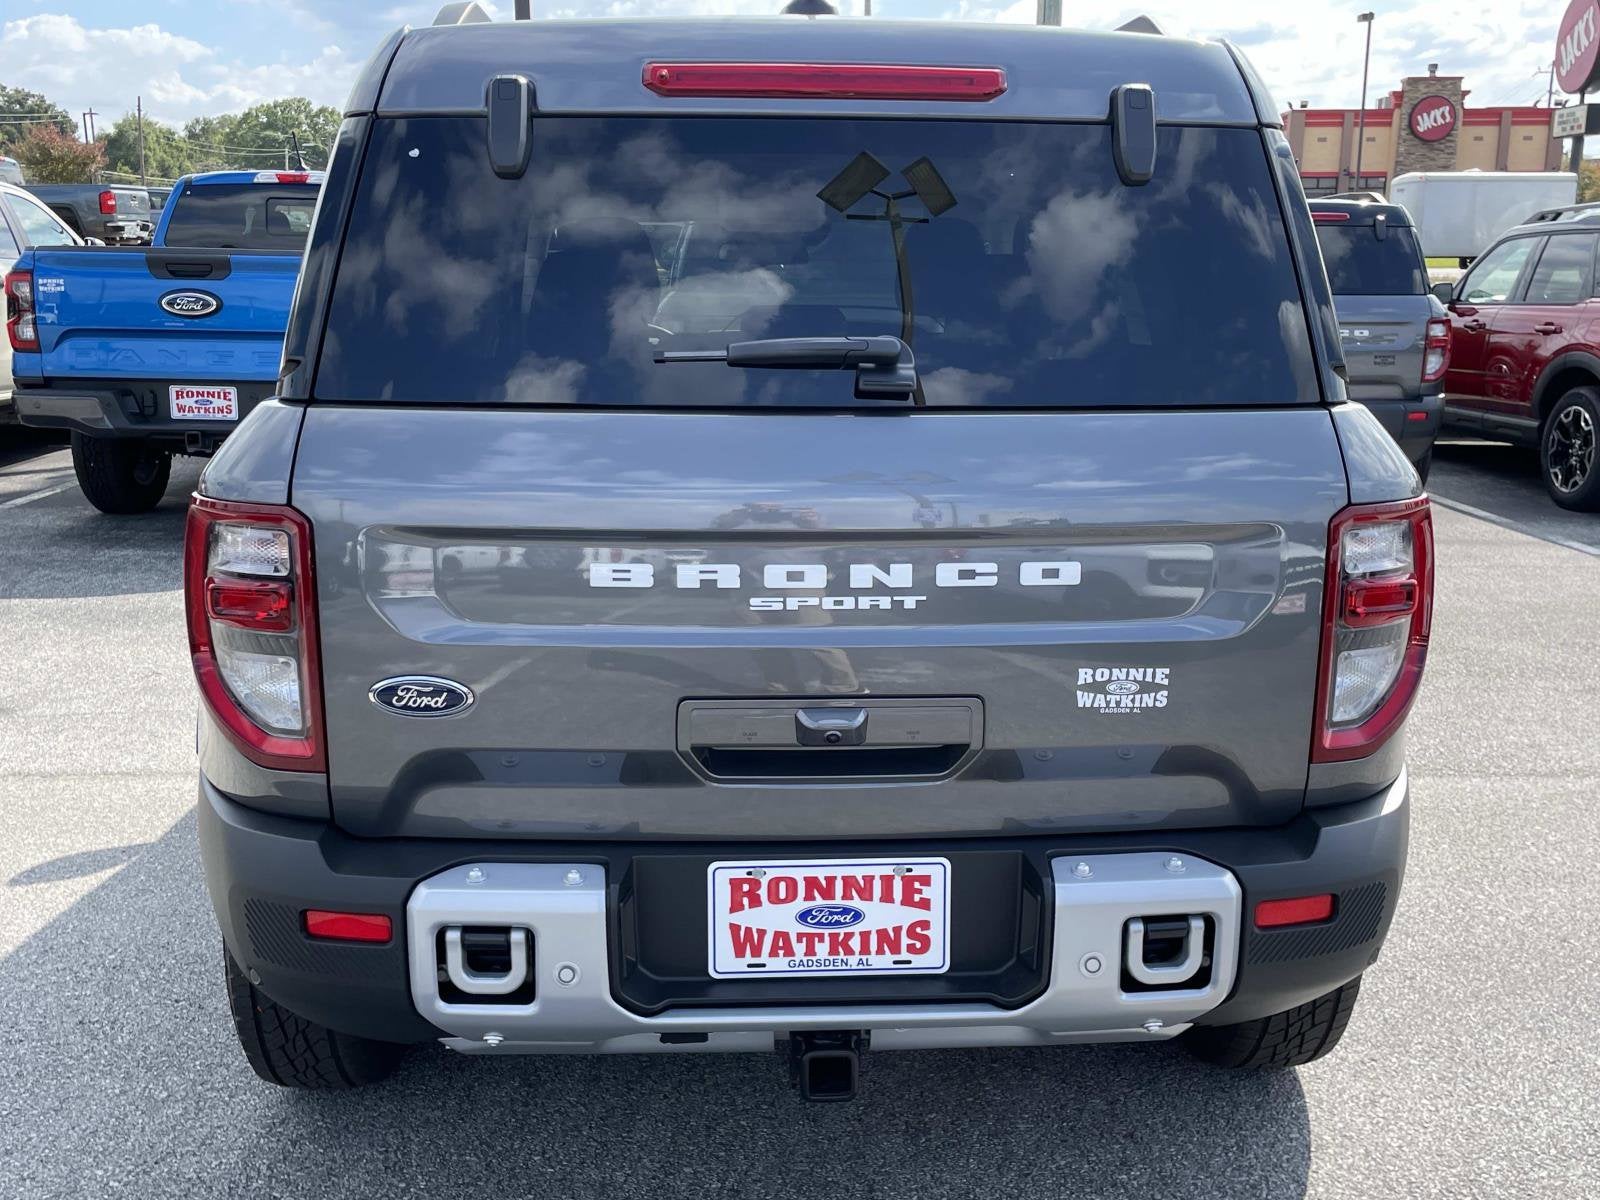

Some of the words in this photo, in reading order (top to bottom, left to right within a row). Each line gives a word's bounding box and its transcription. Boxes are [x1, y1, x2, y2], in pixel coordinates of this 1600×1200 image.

[174, 296, 203, 310] Ford
[175, 390, 232, 402] RONNIE
[176, 403, 233, 415] WATKINS
[589, 561, 1082, 588] BRONCO
[749, 595, 927, 611] SPORT
[1077, 668, 1170, 686] RONNIE
[392, 685, 448, 708] Ford
[1076, 690, 1169, 708] WATKINS
[729, 875, 932, 914] RONNIE
[807, 907, 855, 925] Ford
[729, 919, 932, 959] WATKINS
[788, 958, 853, 969] GADSDEN,
[857, 957, 873, 967] AL
